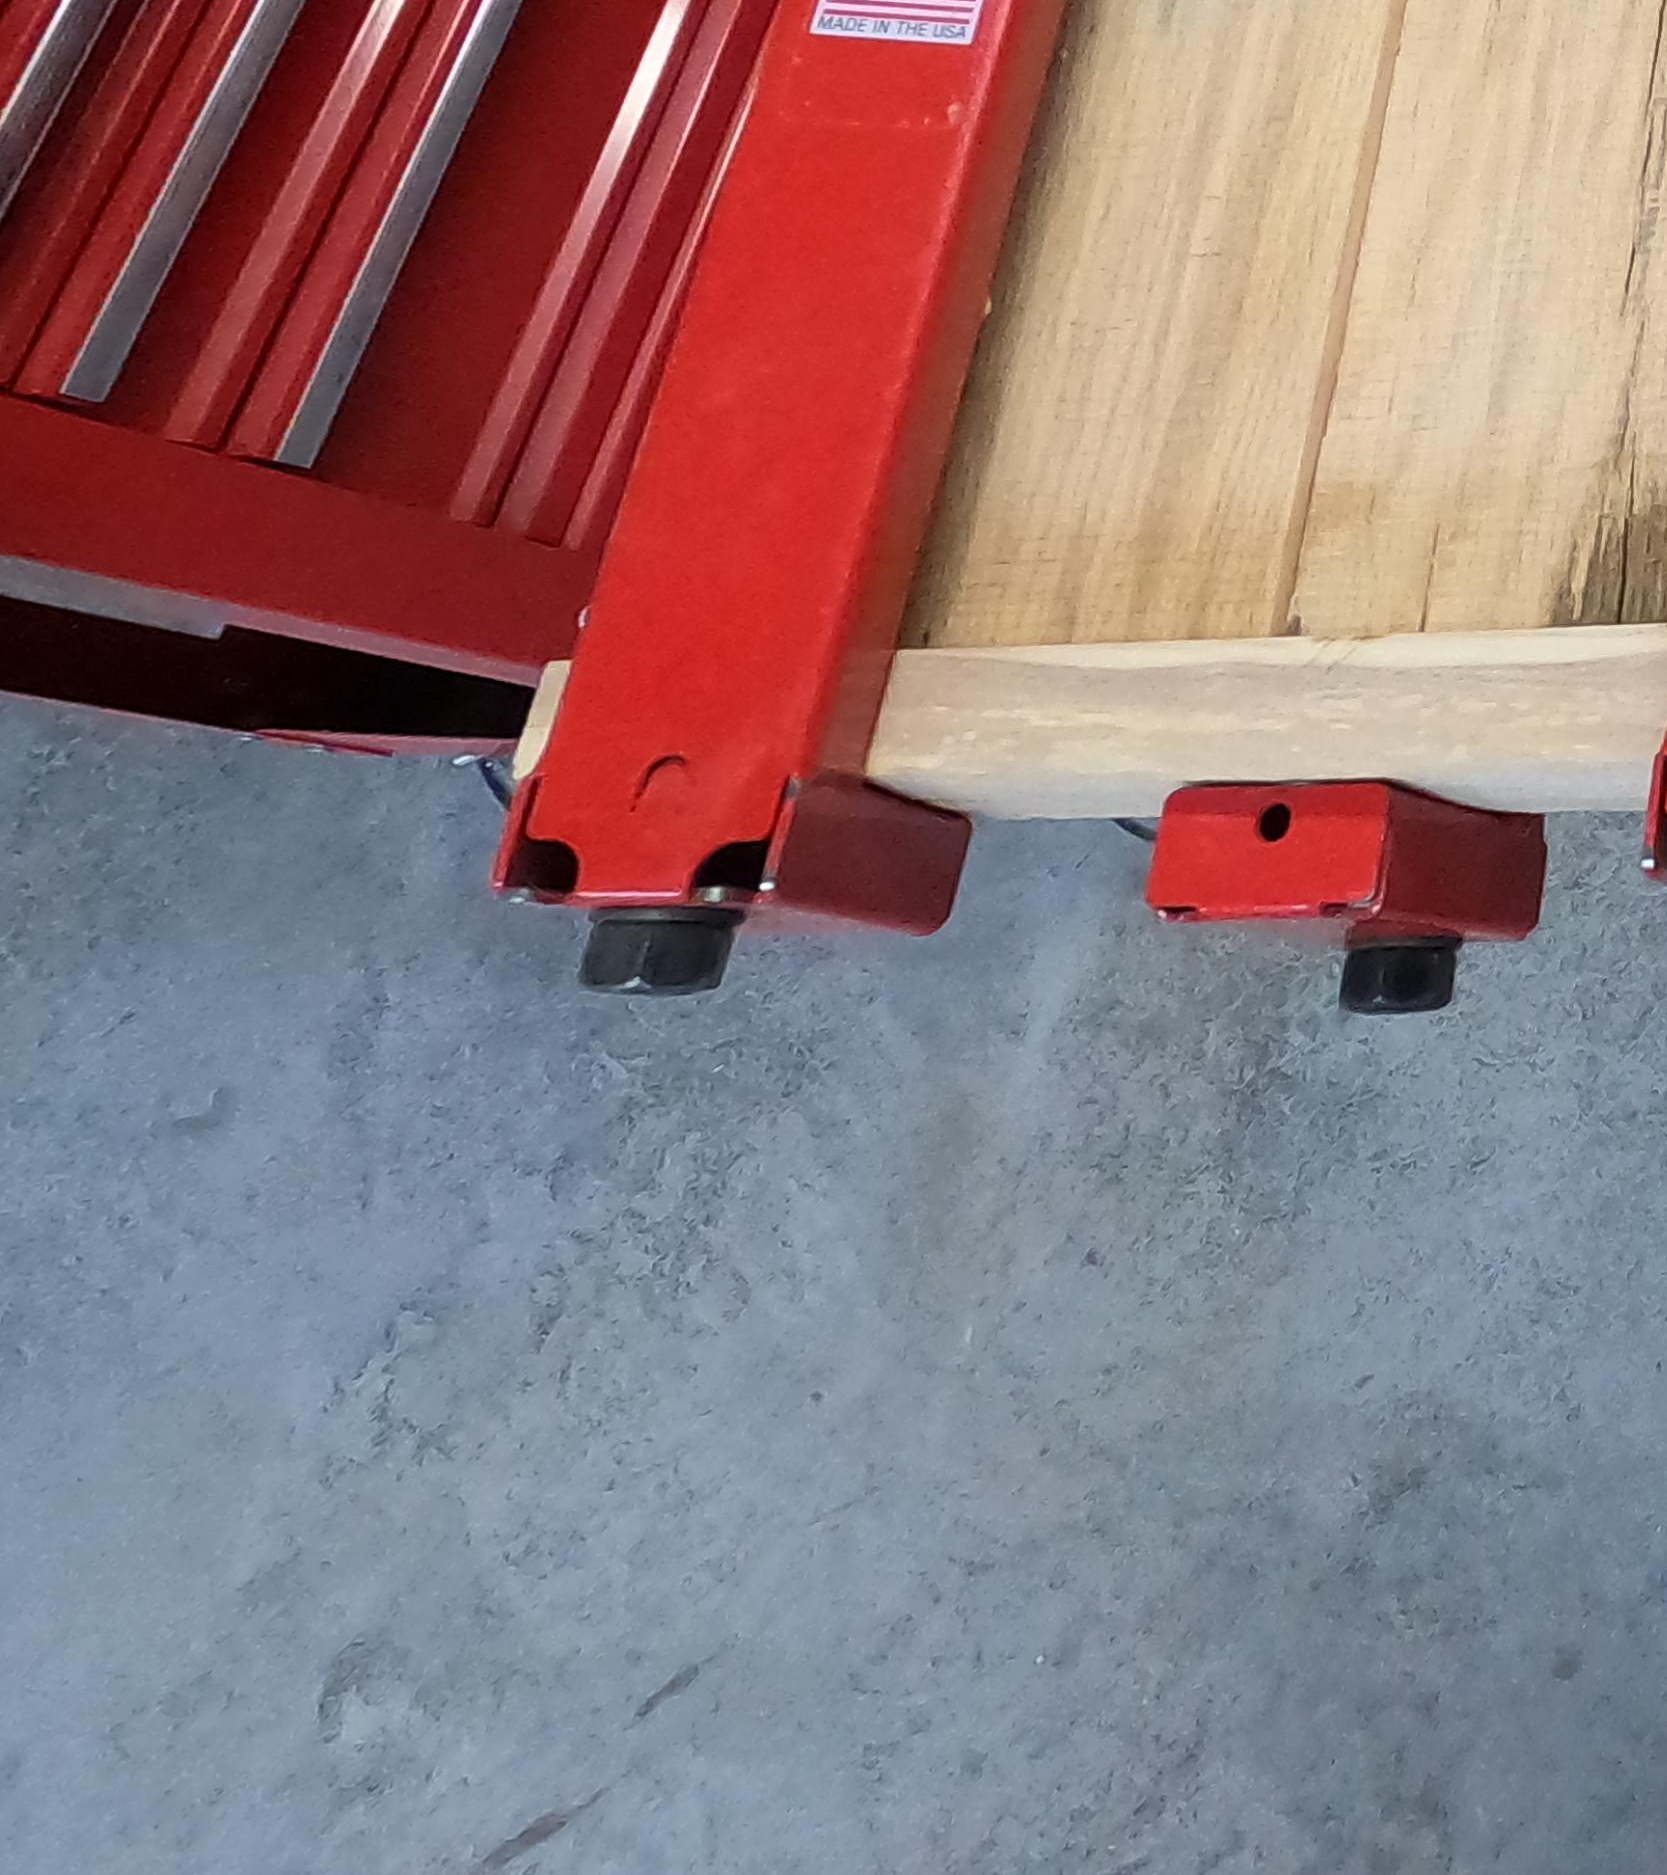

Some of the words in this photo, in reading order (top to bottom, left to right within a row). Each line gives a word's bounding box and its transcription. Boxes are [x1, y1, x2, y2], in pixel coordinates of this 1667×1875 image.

[817, 16, 866, 33] MADE
[872, 19, 890, 34] IN
[897, 21, 928, 37] THE
[932, 23, 967, 39] USA
